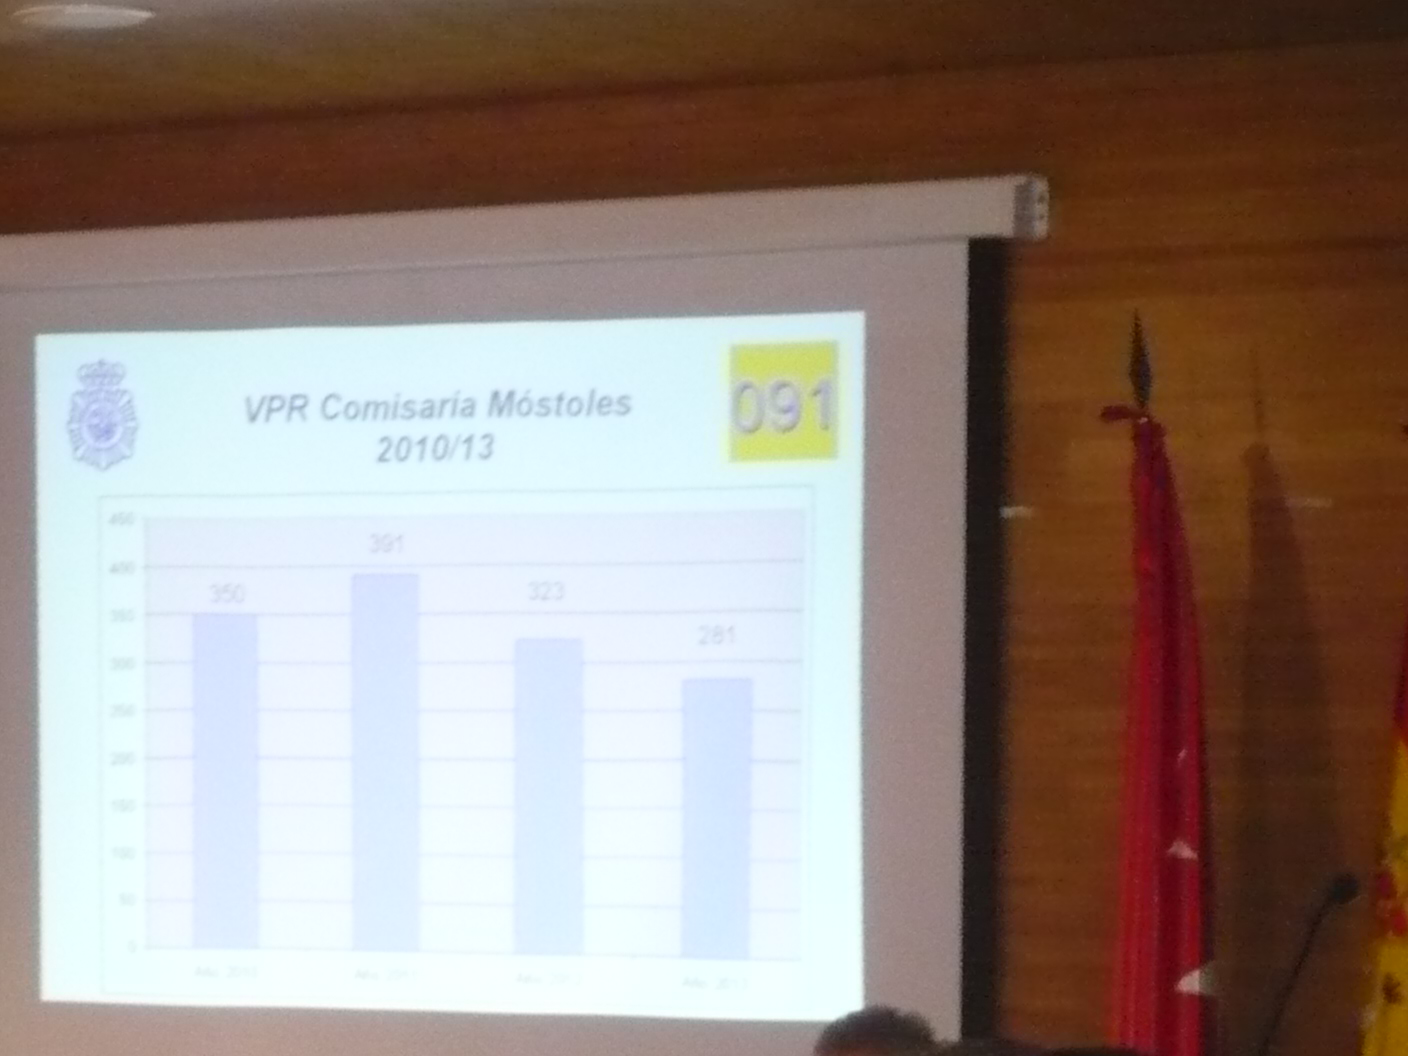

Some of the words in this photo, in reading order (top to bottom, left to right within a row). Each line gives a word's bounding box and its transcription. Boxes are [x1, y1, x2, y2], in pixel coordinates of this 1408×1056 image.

[244, 394, 309, 423] VPR
[320, 389, 476, 421] Comisaría
[487, 389, 633, 418] Móstoles
[731, 379, 835, 433] 091
[377, 432, 495, 463] 2010/13
[369, 533, 406, 554] 391
[209, 582, 247, 604] 350
[528, 581, 565, 602] 323
[699, 625, 737, 646] 281
